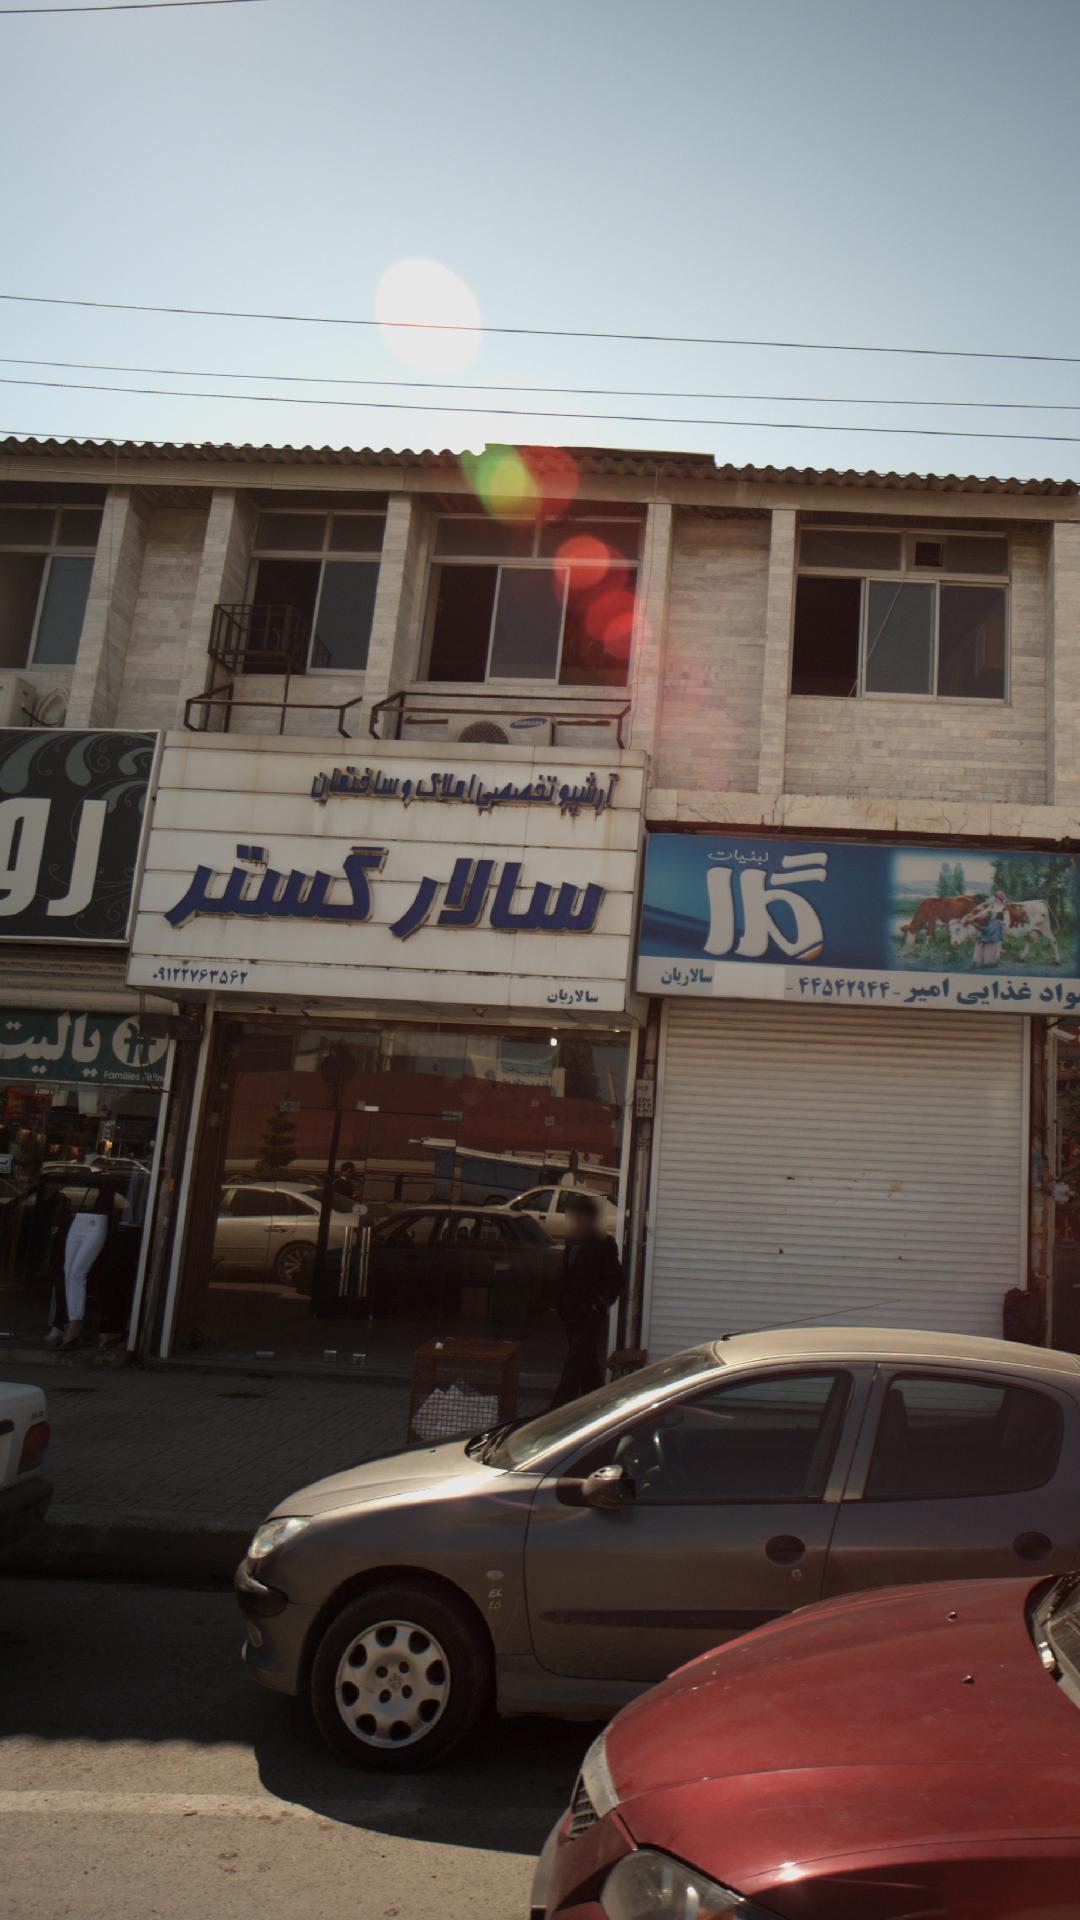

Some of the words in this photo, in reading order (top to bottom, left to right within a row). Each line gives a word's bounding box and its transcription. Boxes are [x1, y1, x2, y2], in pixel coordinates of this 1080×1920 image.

[310, 766, 400, 803] ساختمان
[402, 778, 413, 808] و
[416, 773, 476, 800] املاک
[476, 774, 558, 808] تخصصی
[558, 771, 620, 815] آرشیو
[707, 849, 769, 865] لبنیات
[165, 843, 389, 928] گستر
[389, 857, 604, 941] سالار
[904, 978, 949, 1002] امیر
[956, 980, 1032, 1005] غذایی
[1039, 983, 1080, 1010] واد
